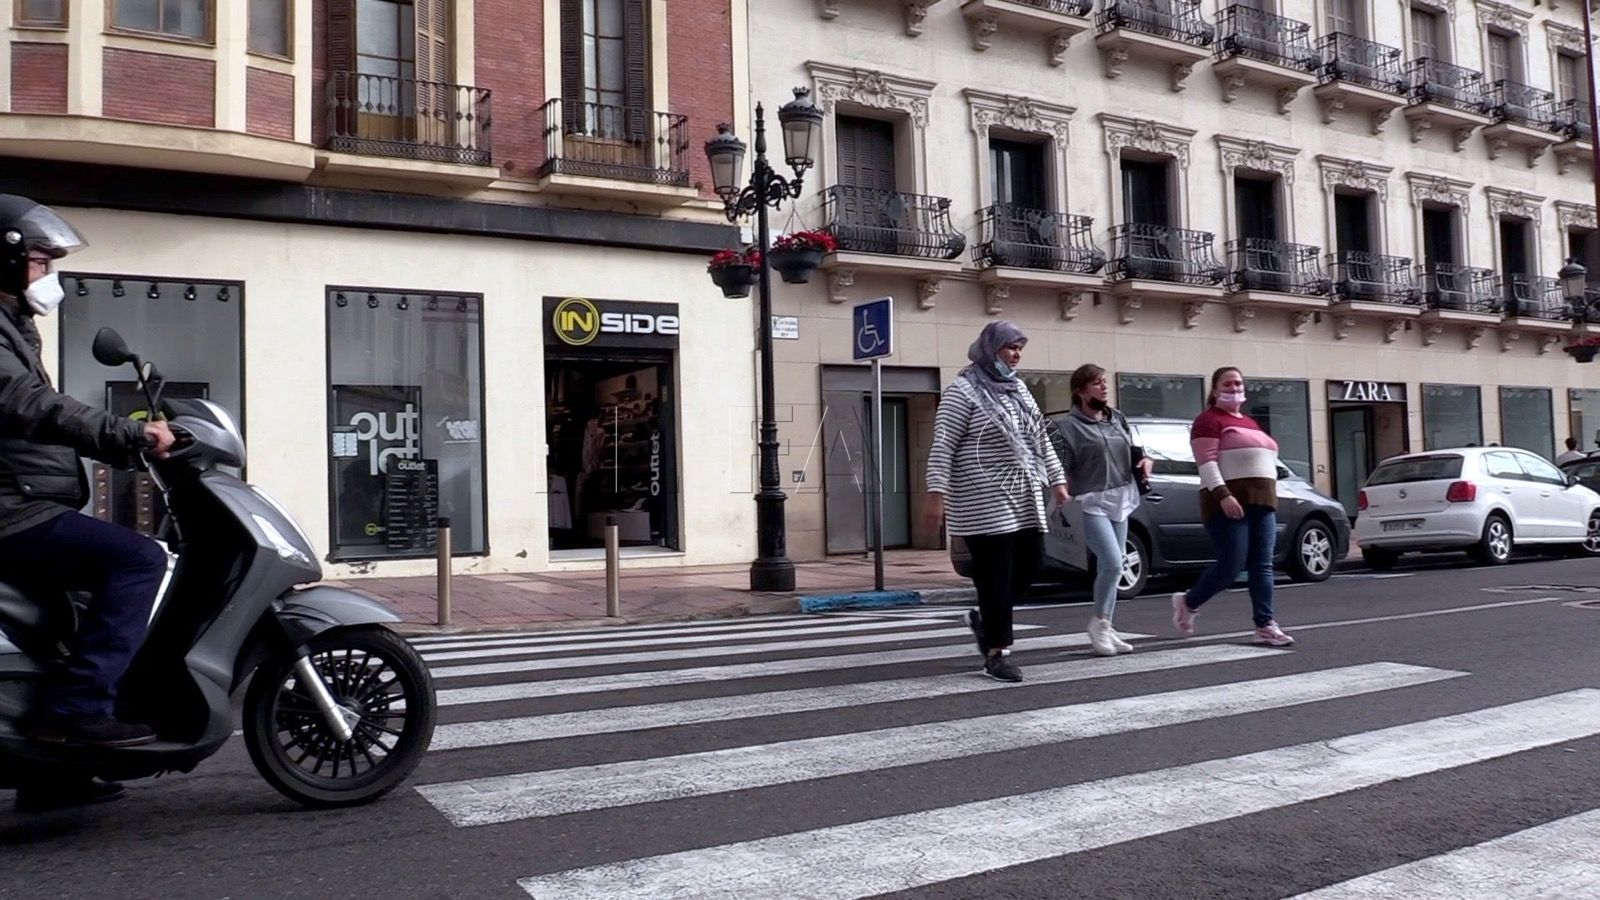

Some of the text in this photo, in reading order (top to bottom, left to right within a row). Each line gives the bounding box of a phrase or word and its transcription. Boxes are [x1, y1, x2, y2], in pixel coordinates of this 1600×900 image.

[1343, 381, 1392, 401] ZARA
[350, 403, 418, 440] out
[398, 461, 425, 471] outlet
[650, 431, 660, 496] outlet
